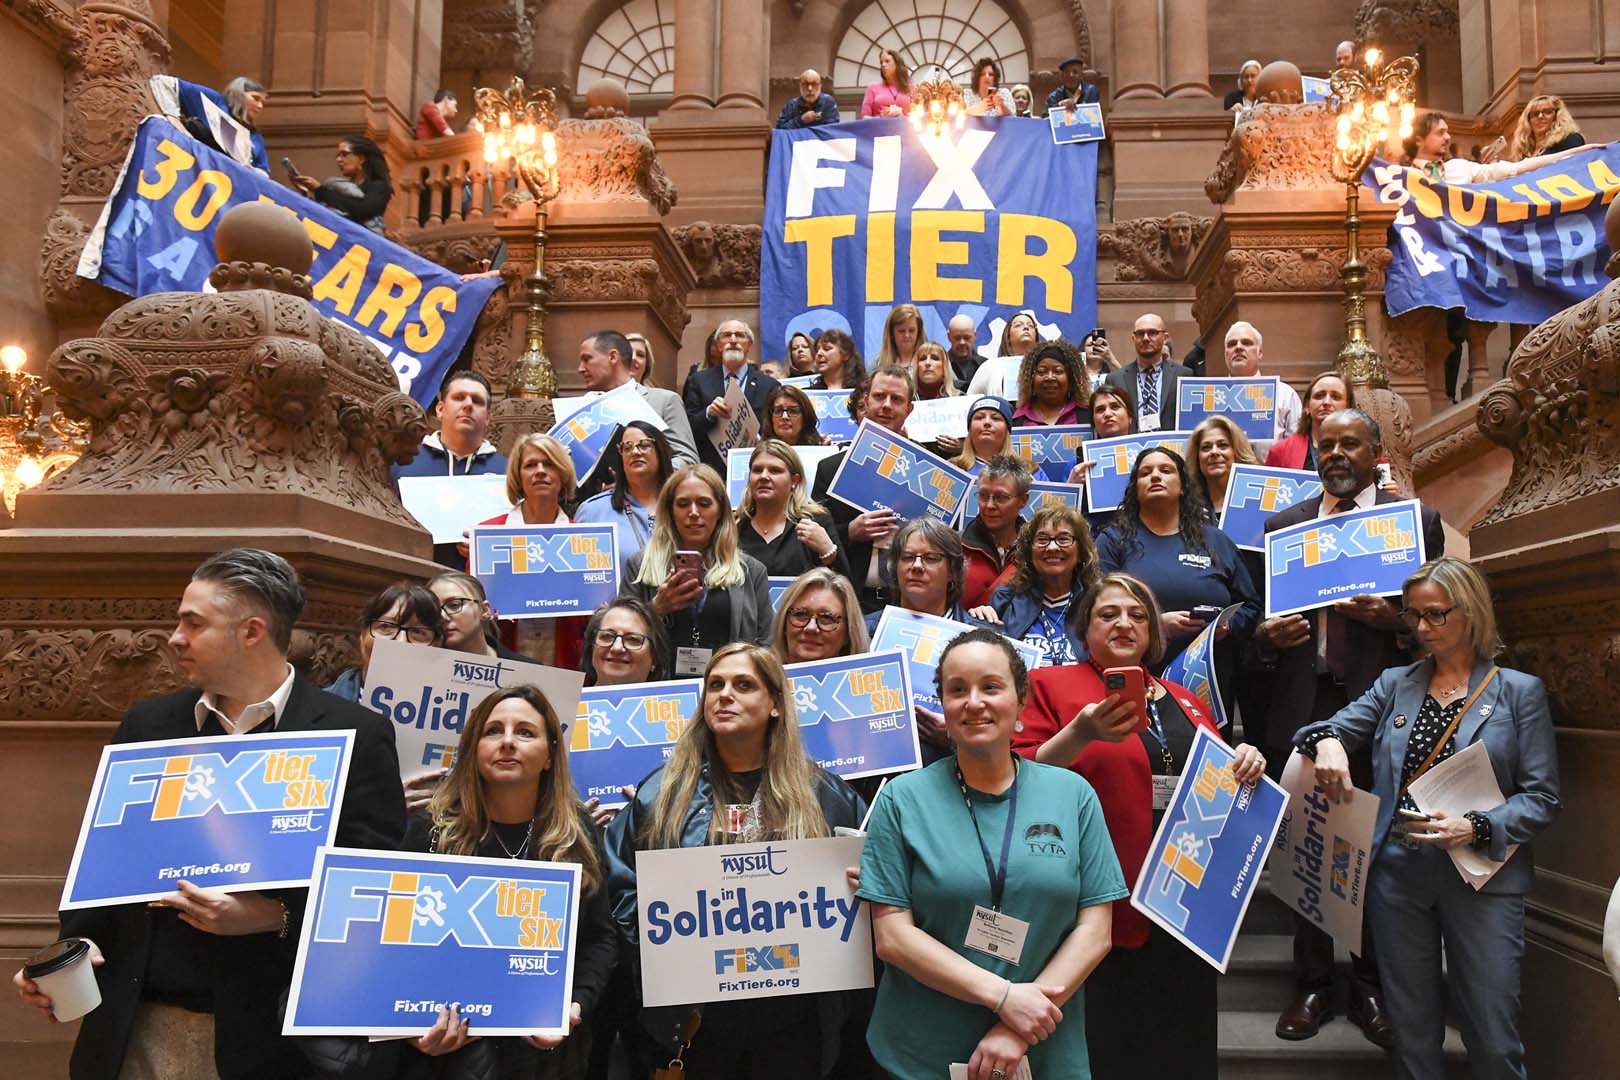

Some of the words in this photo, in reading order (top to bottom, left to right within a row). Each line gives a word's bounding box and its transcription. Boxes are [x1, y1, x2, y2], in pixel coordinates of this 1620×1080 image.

[136, 138, 233, 231] 30
[785, 129, 996, 218] FIX
[783, 210, 1078, 314] TIER
[1381, 549, 1415, 563] nysut
[583, 571, 612, 583] nysut
[1318, 581, 1376, 597] FixTier6.org
[525, 598, 579, 609] FixTier6.org
[452, 659, 515, 689] nysut
[848, 669, 885, 696] tier
[446, 689, 457, 702] in
[871, 685, 904, 713] six
[644, 697, 682, 723] tier
[868, 713, 905, 731] nysut
[263, 751, 316, 783] tier
[282, 775, 330, 809] six
[270, 810, 325, 832] nysut
[158, 862, 251, 880] FixTier6.org
[720, 846, 788, 875] nysut
[1231, 834, 1262, 899] FixTier6.org
[496, 880, 546, 917] tier
[721, 888, 734, 900] in
[647, 886, 861, 945] Solidarity
[519, 912, 564, 948] six
[508, 951, 561, 976] nysut
[719, 978, 800, 992] FixTier6.org
